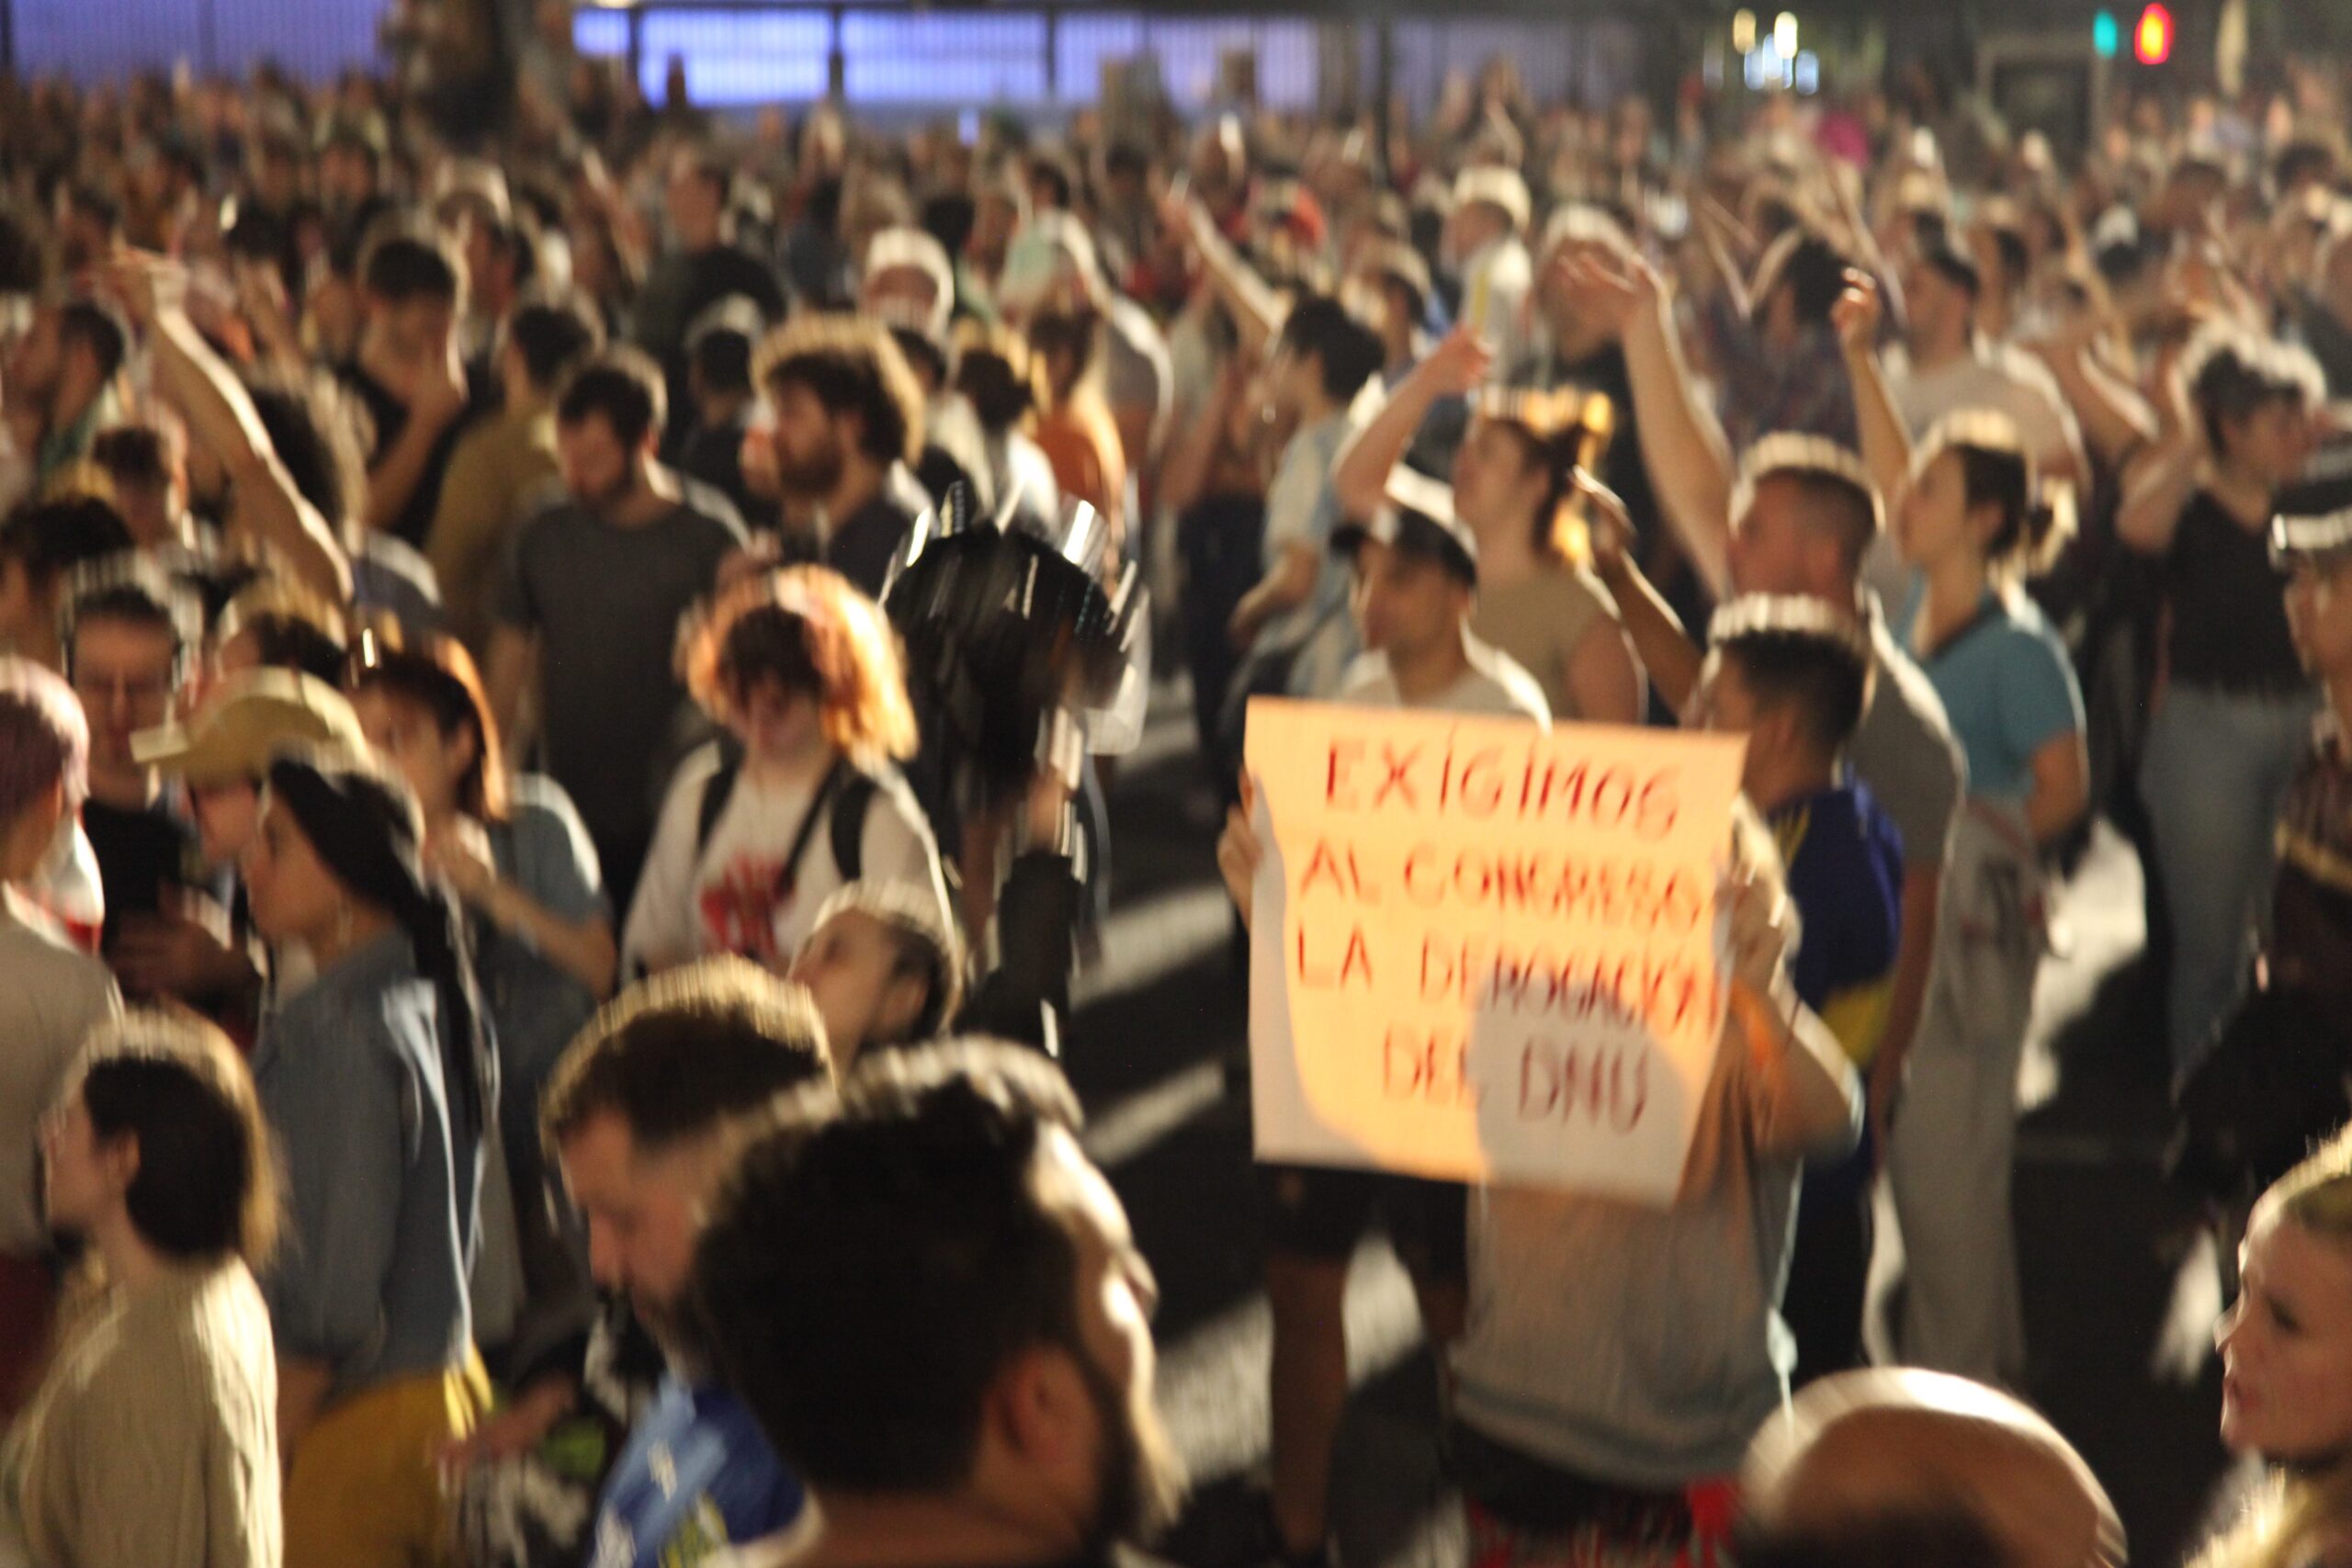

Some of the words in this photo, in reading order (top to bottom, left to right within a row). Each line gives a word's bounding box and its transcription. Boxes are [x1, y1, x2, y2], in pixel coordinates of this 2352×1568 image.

[1299, 838, 1381, 904] AL
[1298, 919, 1373, 990] LA
[1382, 1021, 1484, 1111] DEL
[1518, 1031, 1650, 1136] DNU
